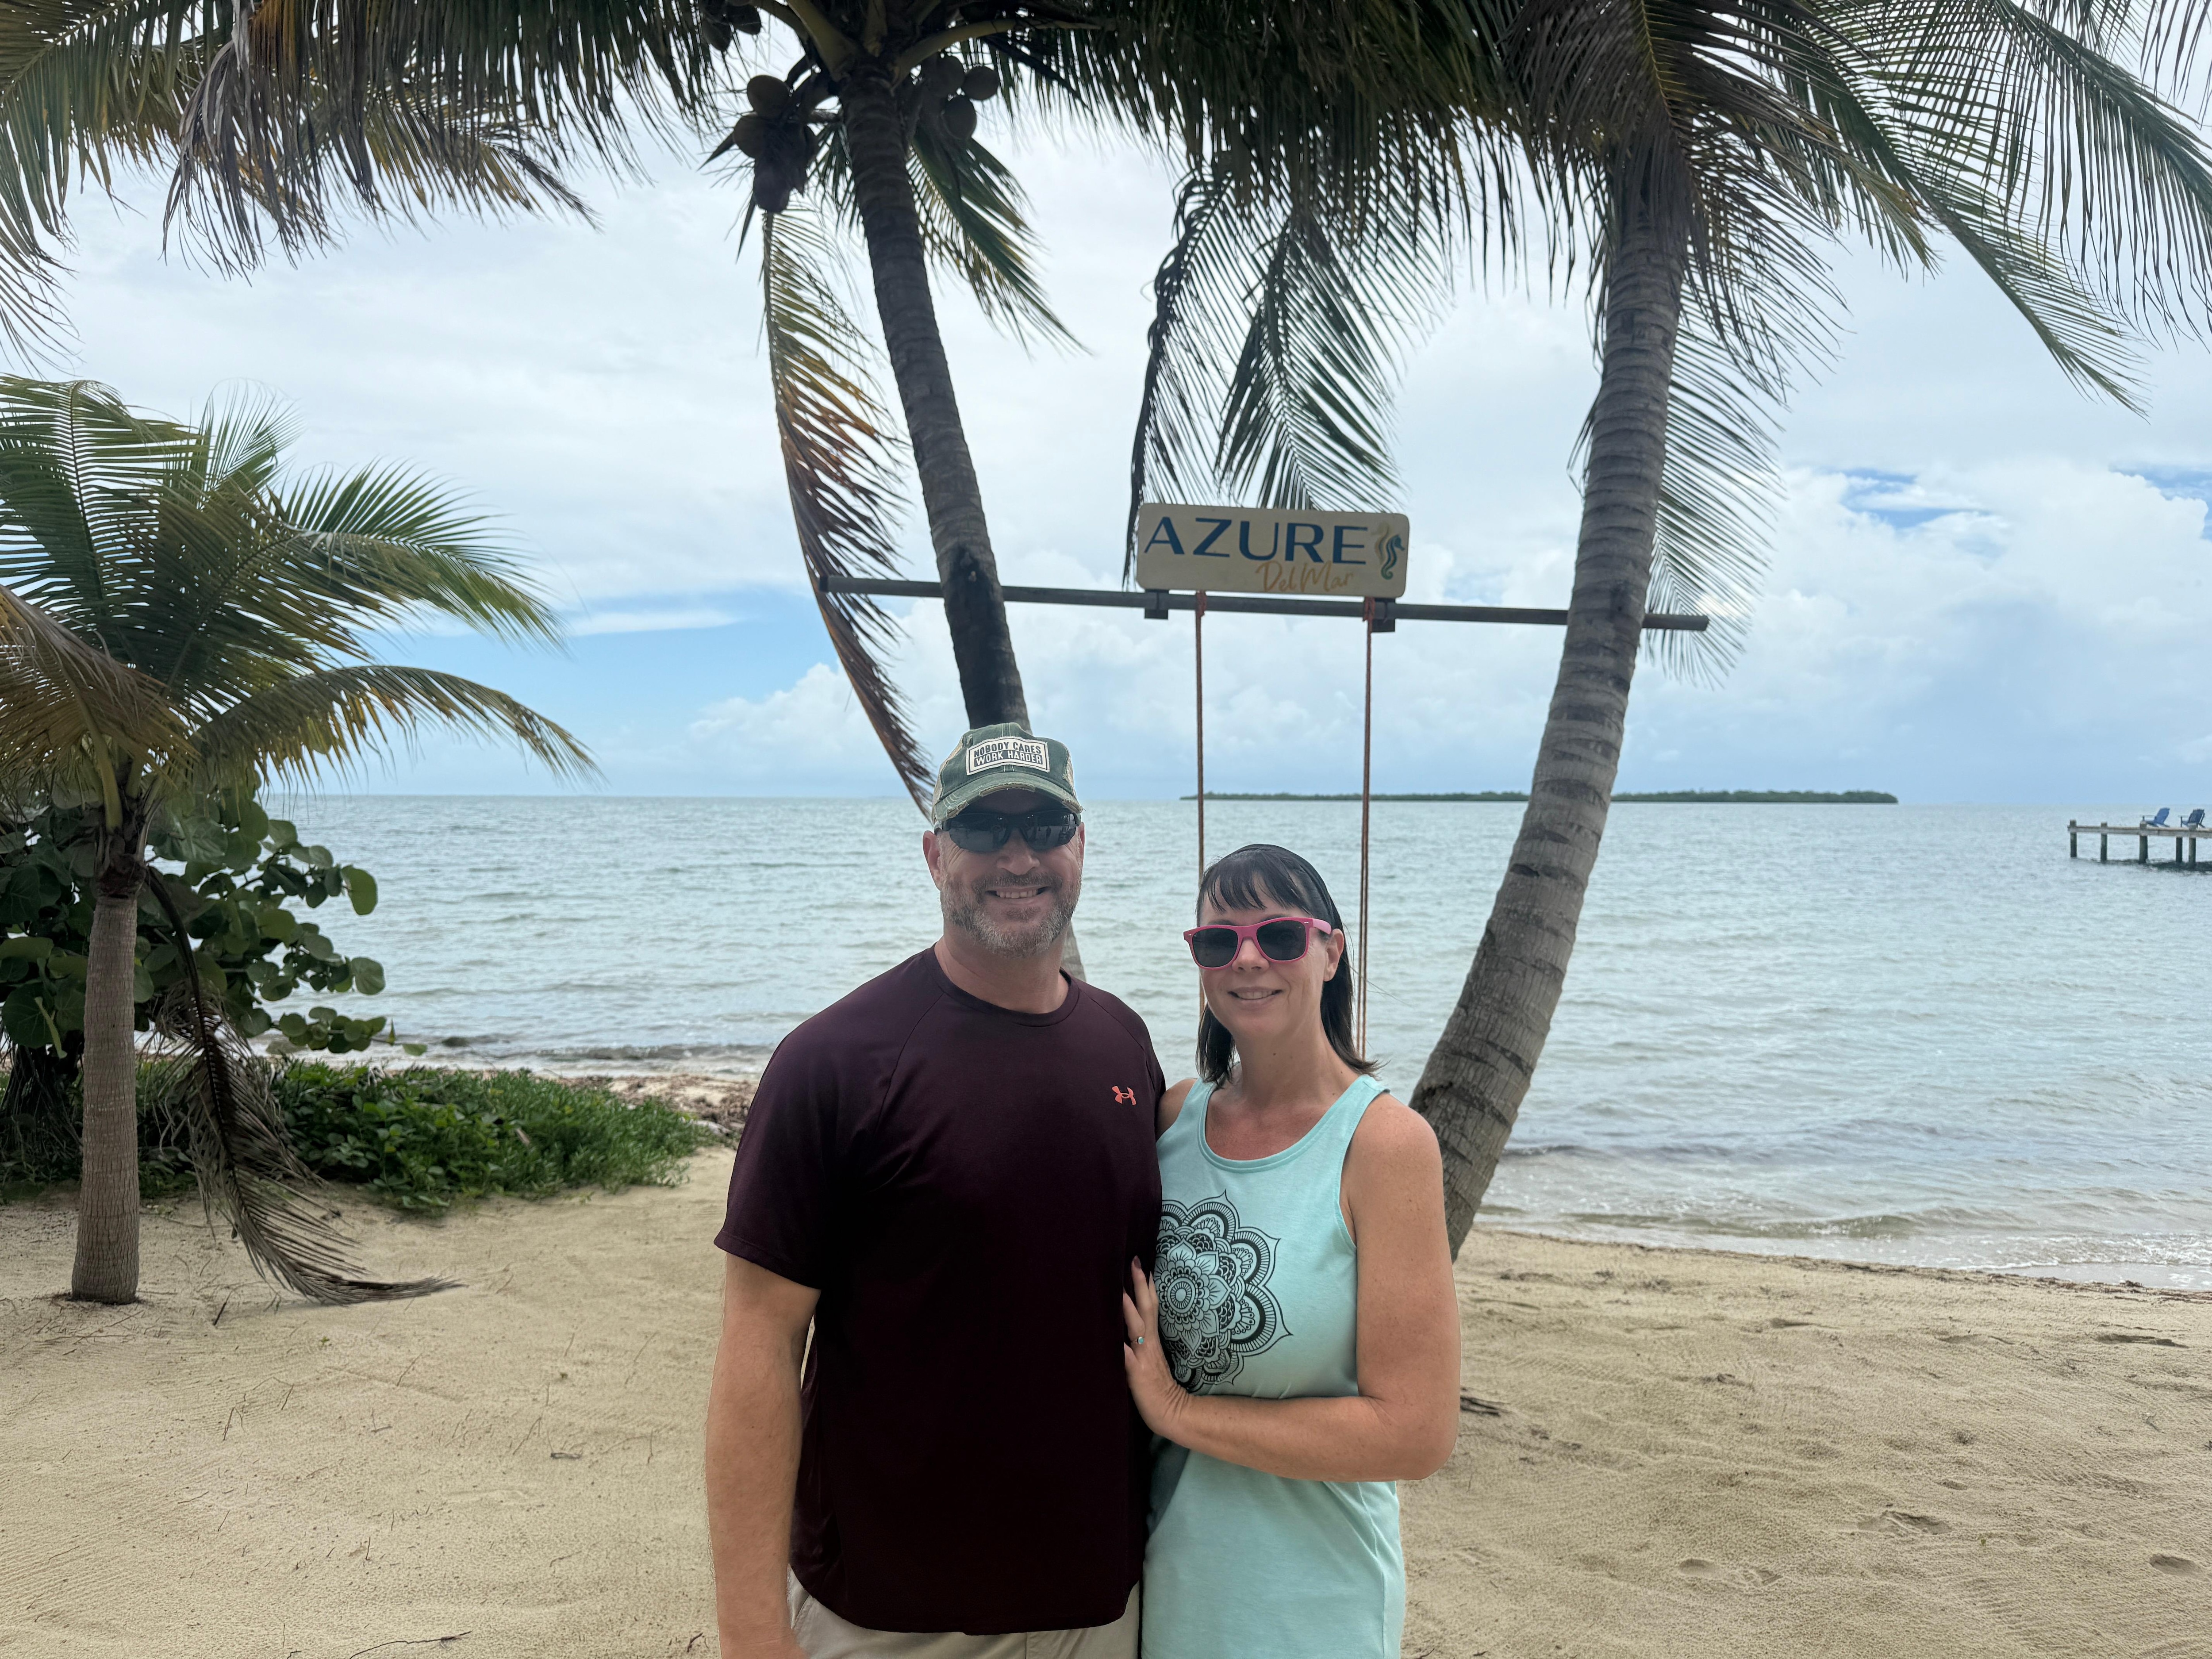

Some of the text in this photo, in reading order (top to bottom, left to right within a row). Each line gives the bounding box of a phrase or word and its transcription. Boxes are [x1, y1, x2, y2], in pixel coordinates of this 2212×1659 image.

[1144, 517, 1368, 565] AZURE
[974, 742, 1041, 757] NOBODY CARES
[976, 751, 1042, 765] WORK HARDER
